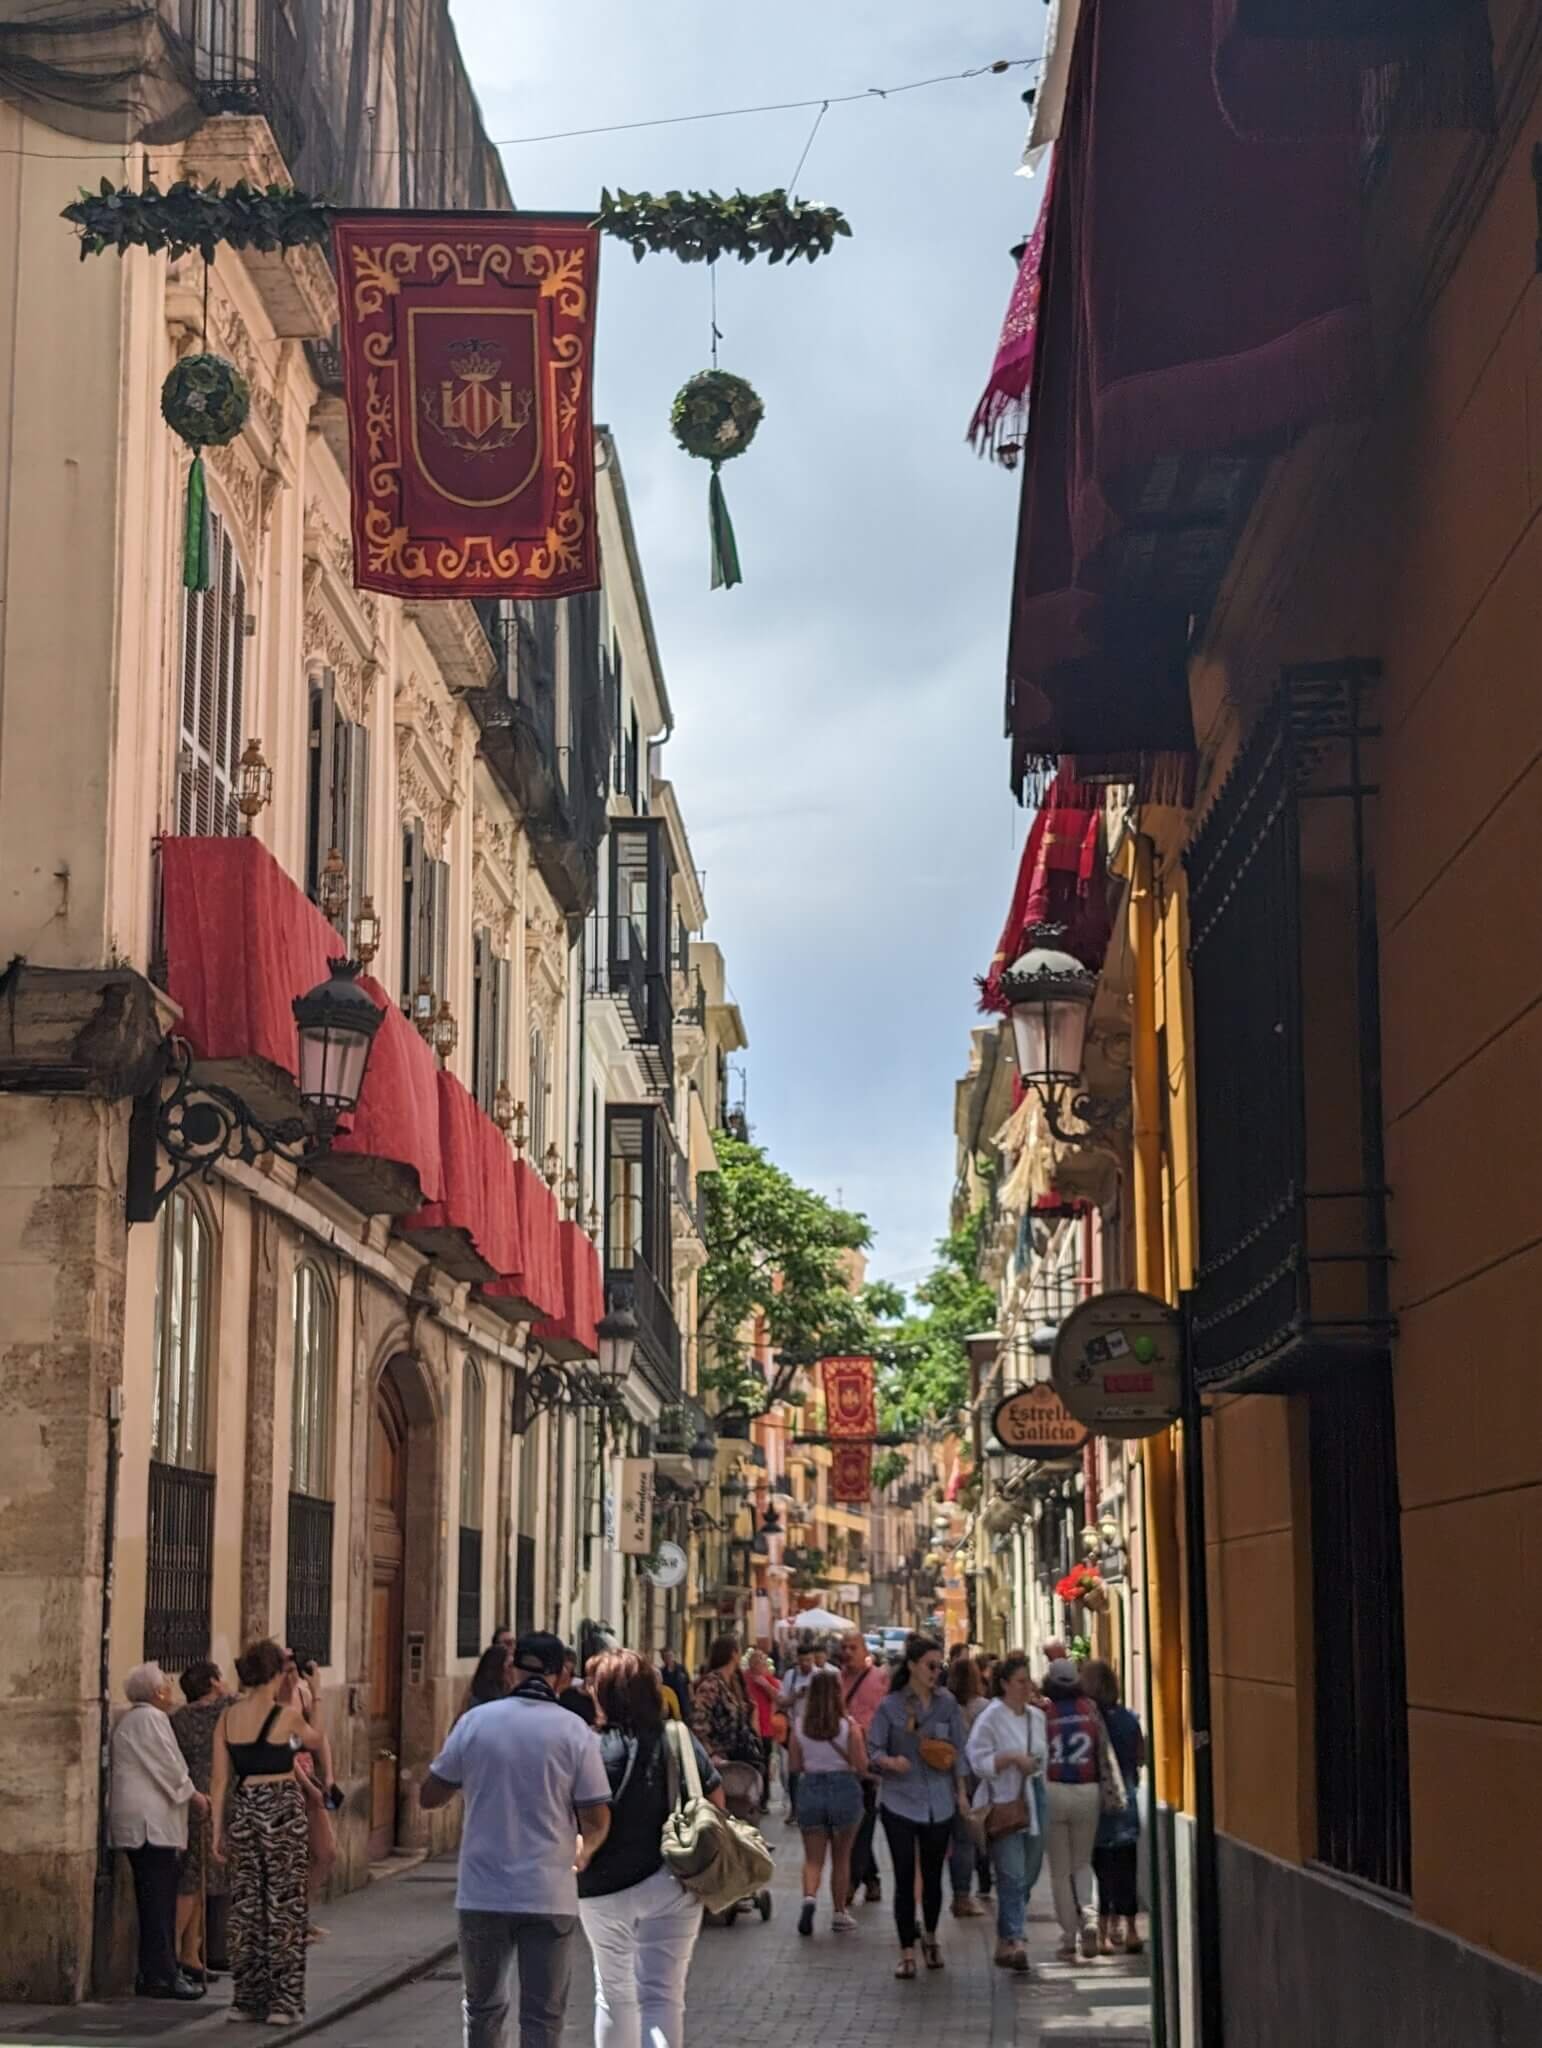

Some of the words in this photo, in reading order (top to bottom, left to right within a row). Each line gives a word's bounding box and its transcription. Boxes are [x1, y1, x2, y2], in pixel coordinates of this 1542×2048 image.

[1009, 1404, 1070, 1420] Estrell
[1010, 1422, 1076, 1440] Galicia
[1050, 1732, 1092, 1764] 12
